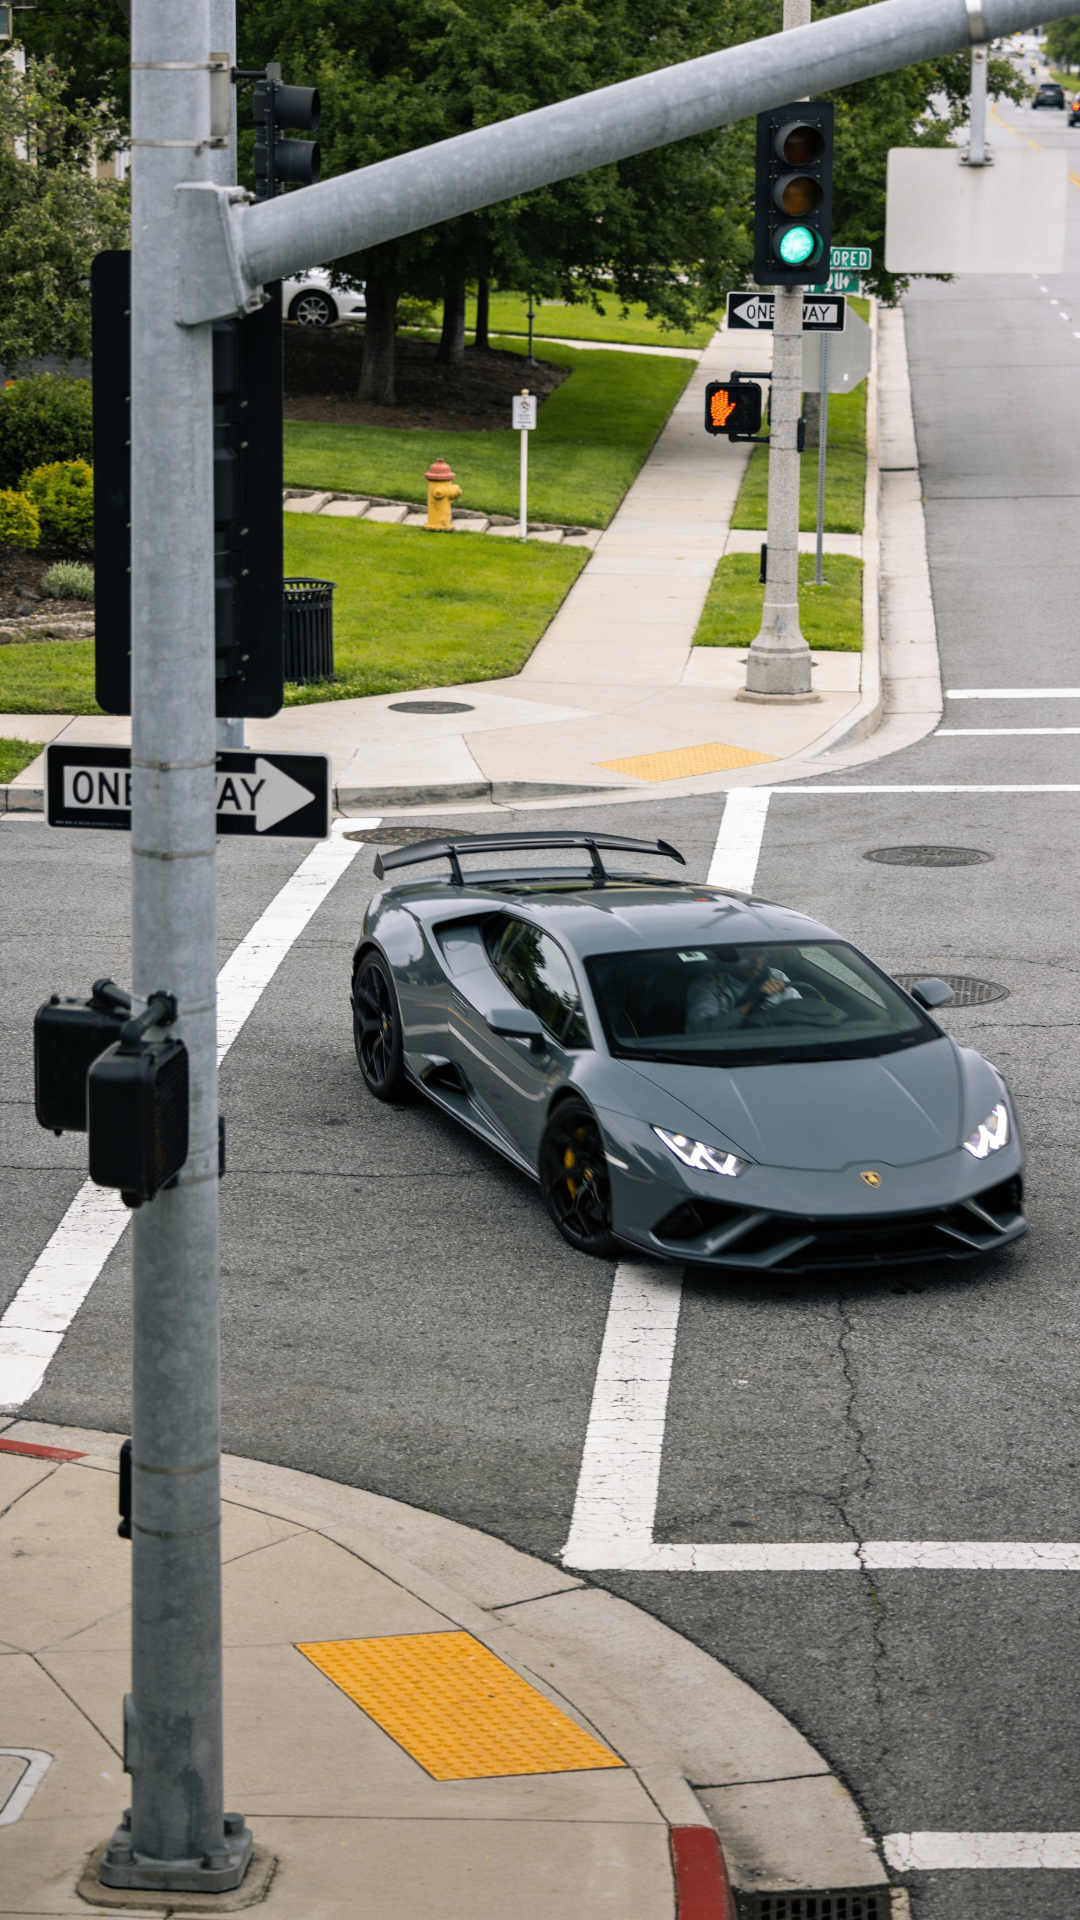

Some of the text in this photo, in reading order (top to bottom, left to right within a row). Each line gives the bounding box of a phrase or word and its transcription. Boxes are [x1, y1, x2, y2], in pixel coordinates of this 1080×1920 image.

[830, 250, 867, 266] ORED
[746, 304, 775, 319] ONE
[215, 777, 266, 811] AY
